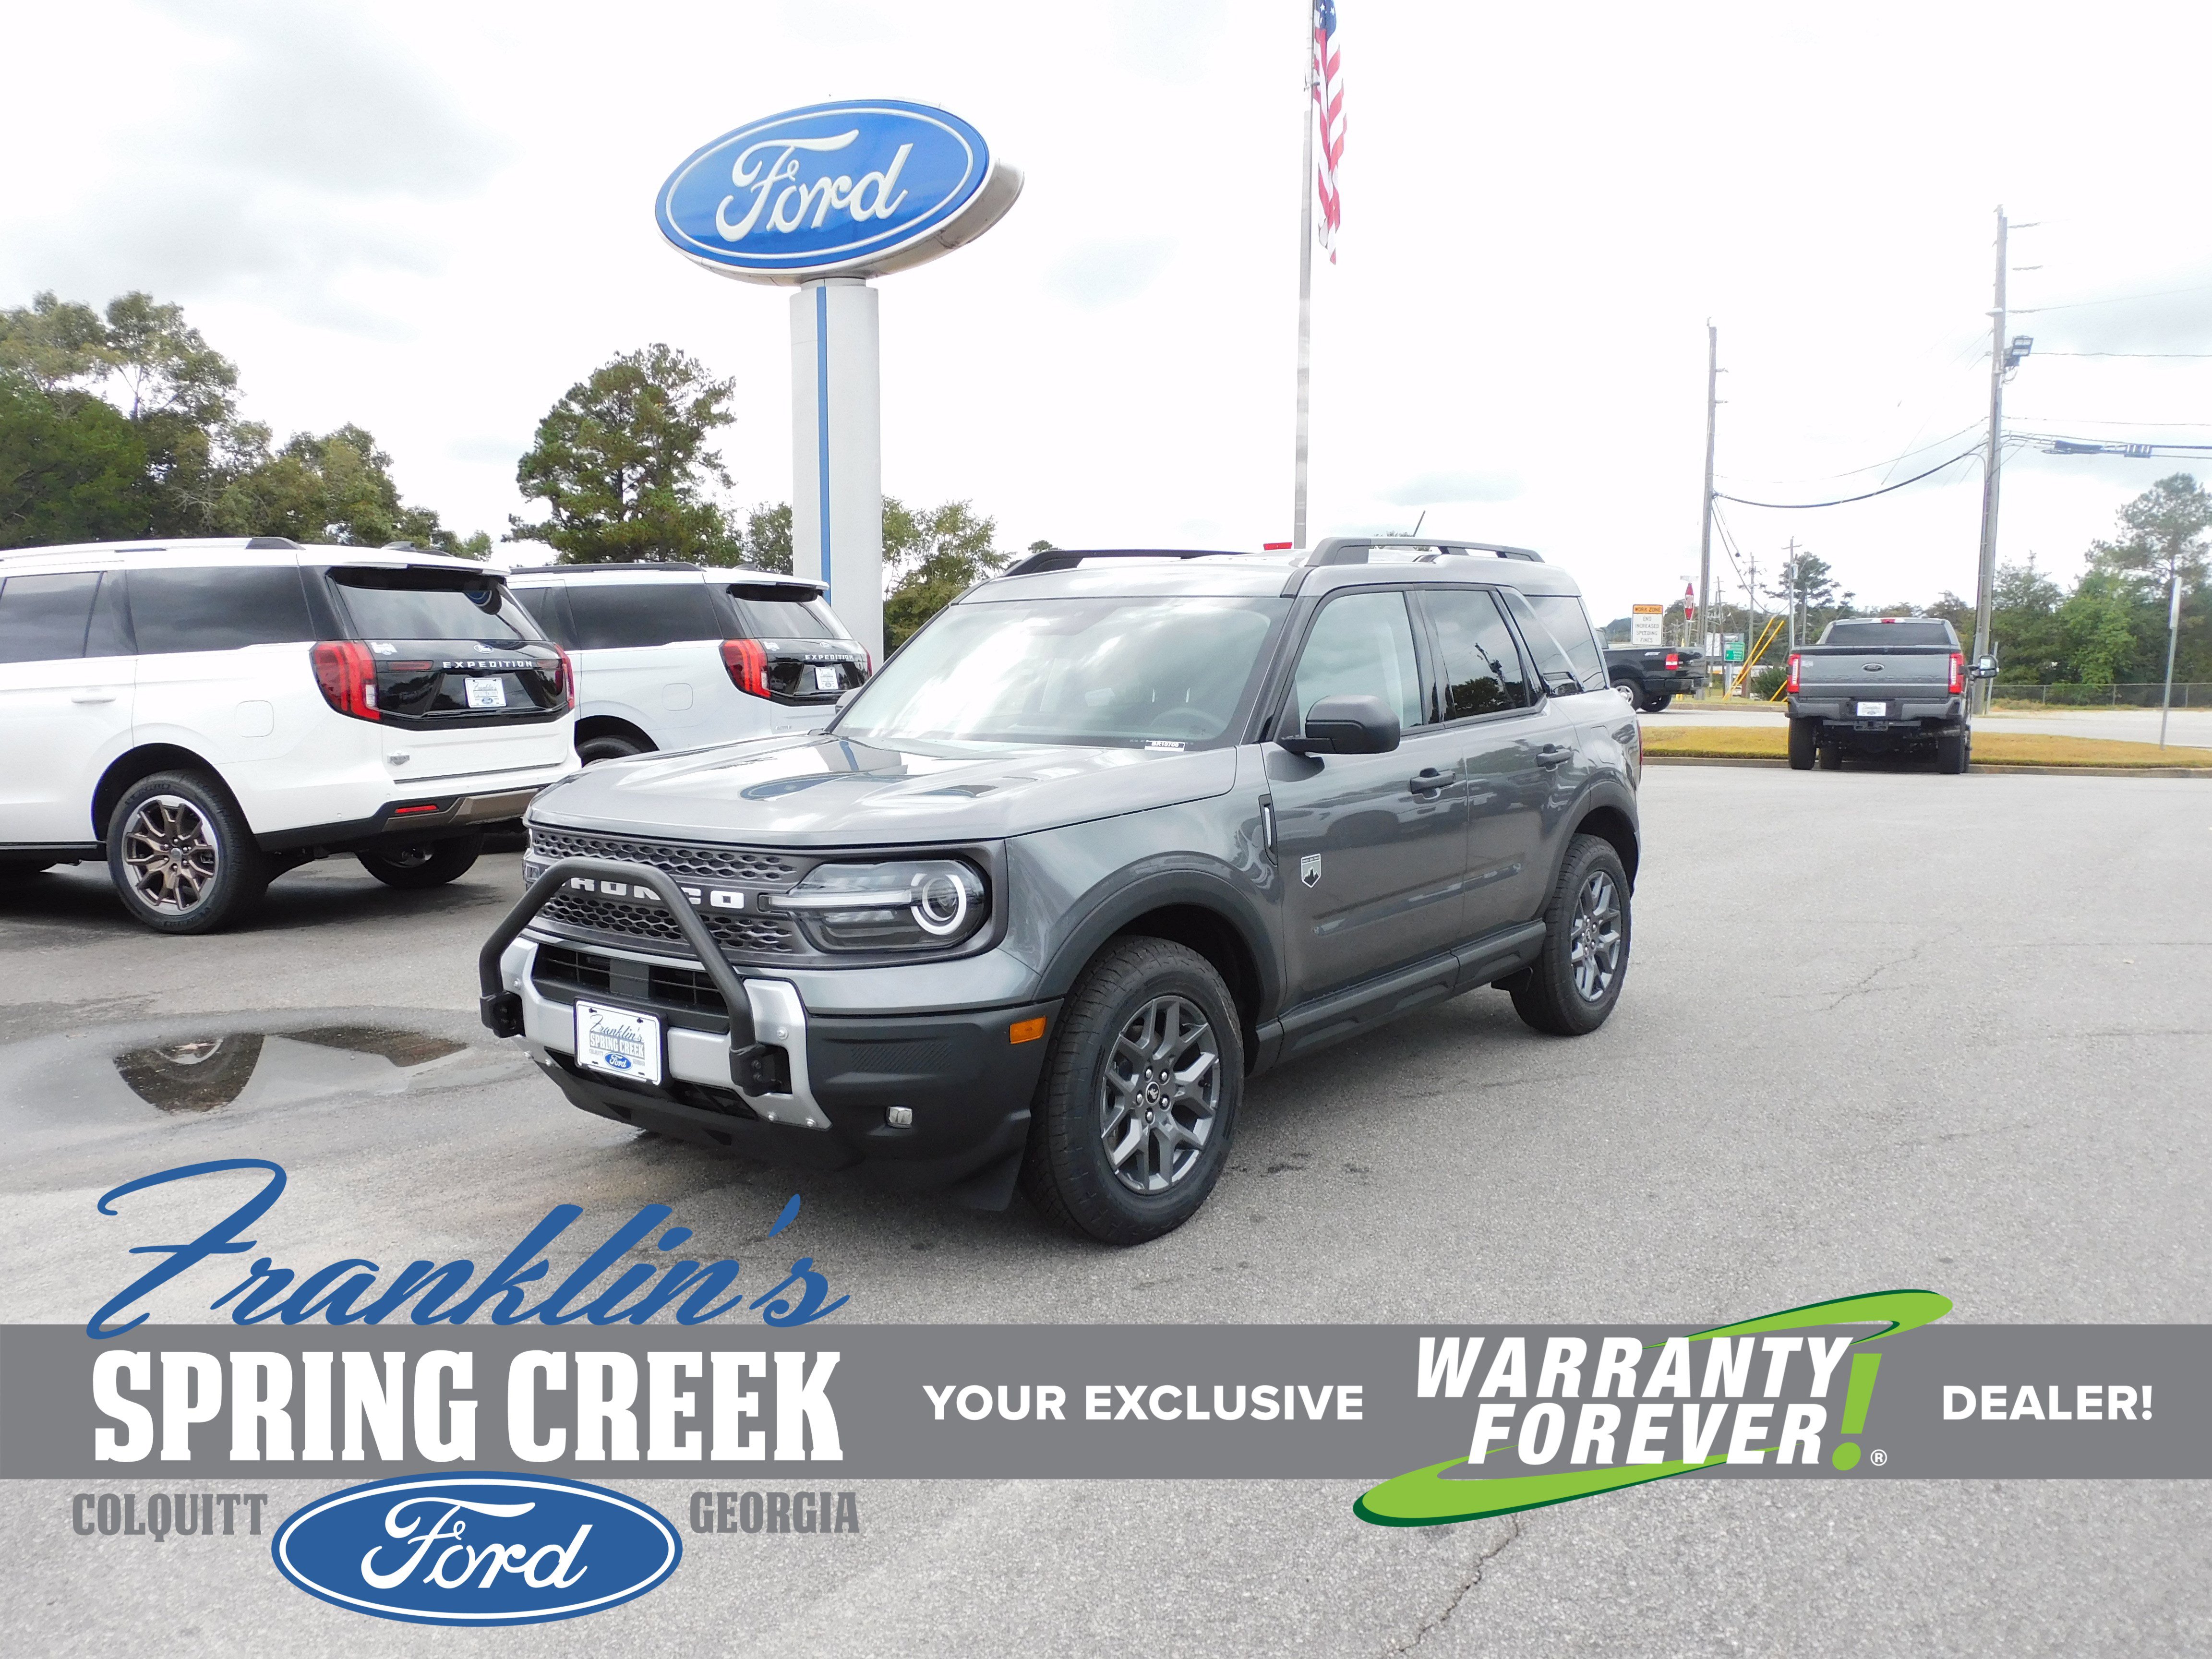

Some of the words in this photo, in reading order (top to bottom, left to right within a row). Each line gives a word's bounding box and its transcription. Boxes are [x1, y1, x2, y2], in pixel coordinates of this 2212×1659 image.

[716, 129, 914, 242] Ford
[443, 661, 533, 669] EXPEDITION
[562, 878, 745, 909] RONCO
[590, 1014, 644, 1043] Franklin's
[590, 1032, 618, 1051] SPRING
[619, 1040, 644, 1058] CREEK
[609, 1054, 627, 1068] Ford
